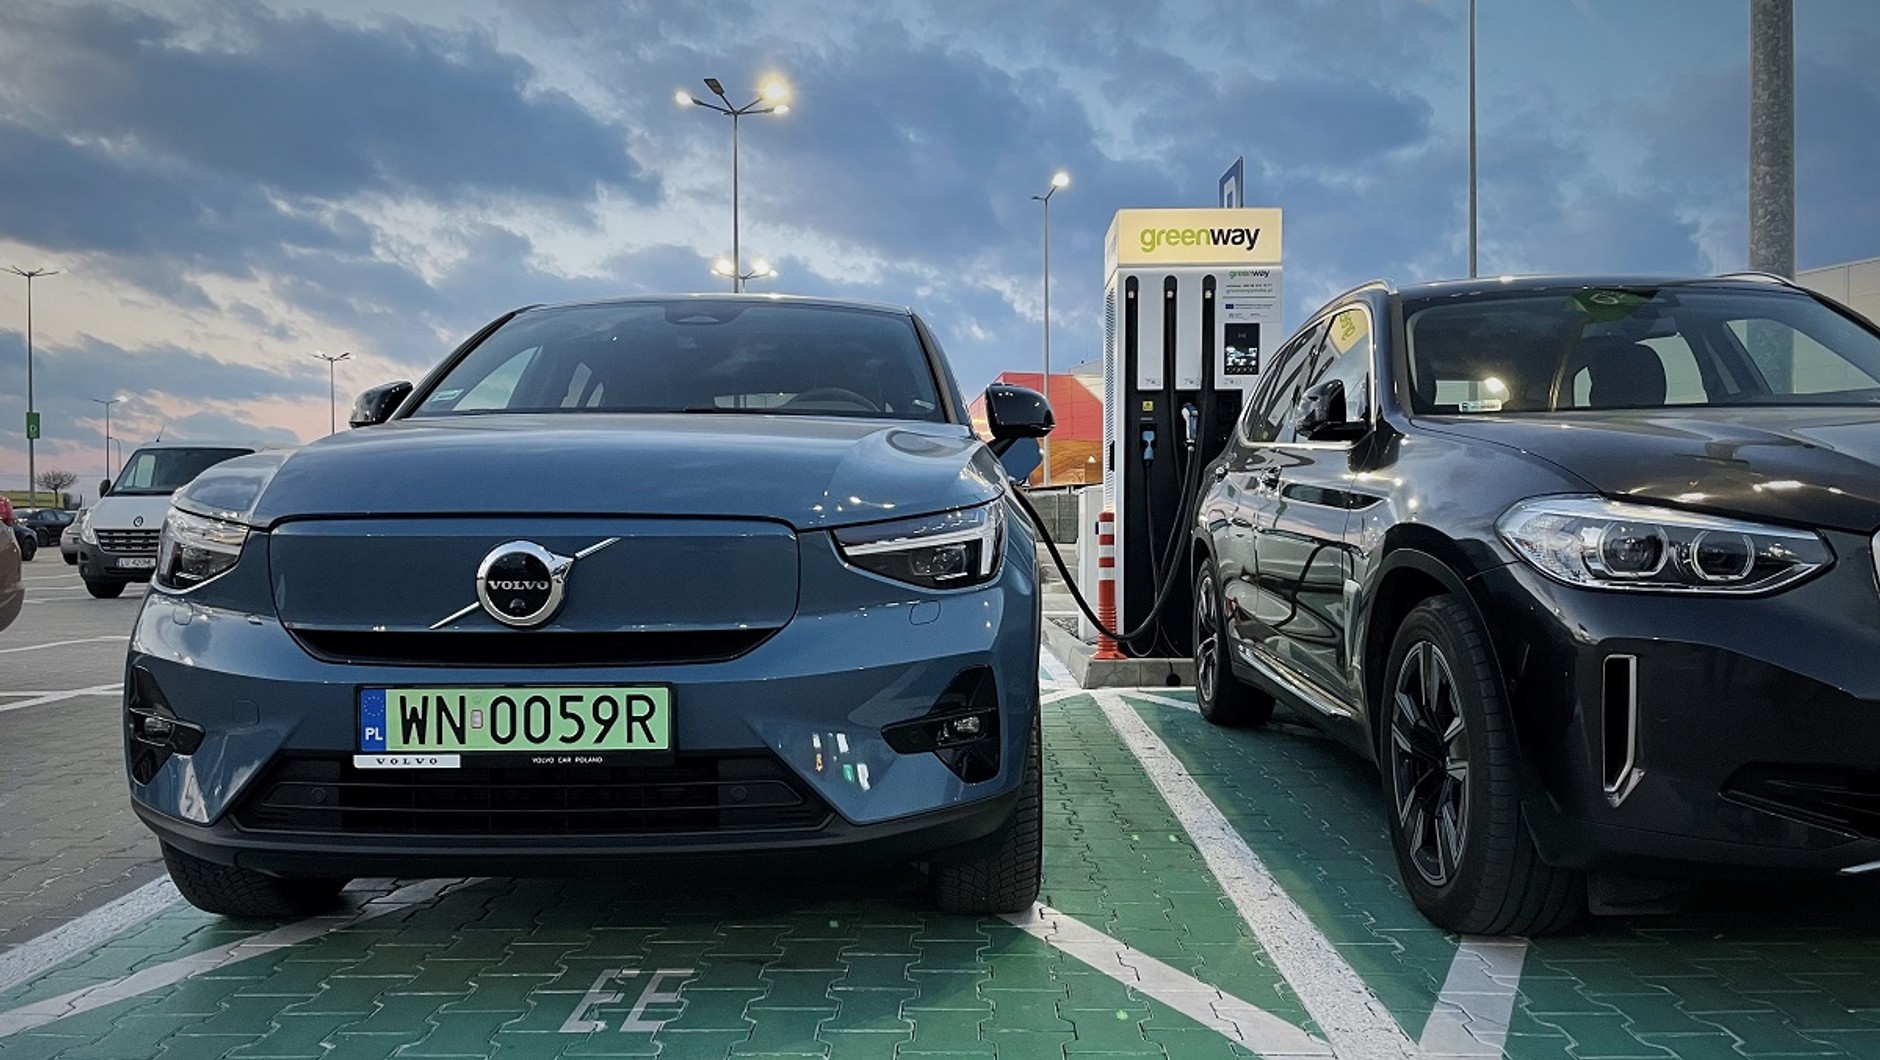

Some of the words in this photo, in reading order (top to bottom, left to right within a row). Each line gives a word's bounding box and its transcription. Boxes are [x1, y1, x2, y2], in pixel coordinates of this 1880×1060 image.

[1140, 228, 1260, 253] greenway
[1228, 269, 1270, 279] greenway
[488, 580, 550, 590] VOLVO
[400, 695, 466, 745] WN
[490, 693, 656, 745] 0059R
[365, 727, 383, 740] PL
[376, 757, 438, 766] VOLVO
[532, 756, 555, 764] VOLVO
[557, 756, 572, 764] CAR
[574, 756, 604, 764] POLAND
[558, 967, 695, 1033] EE
